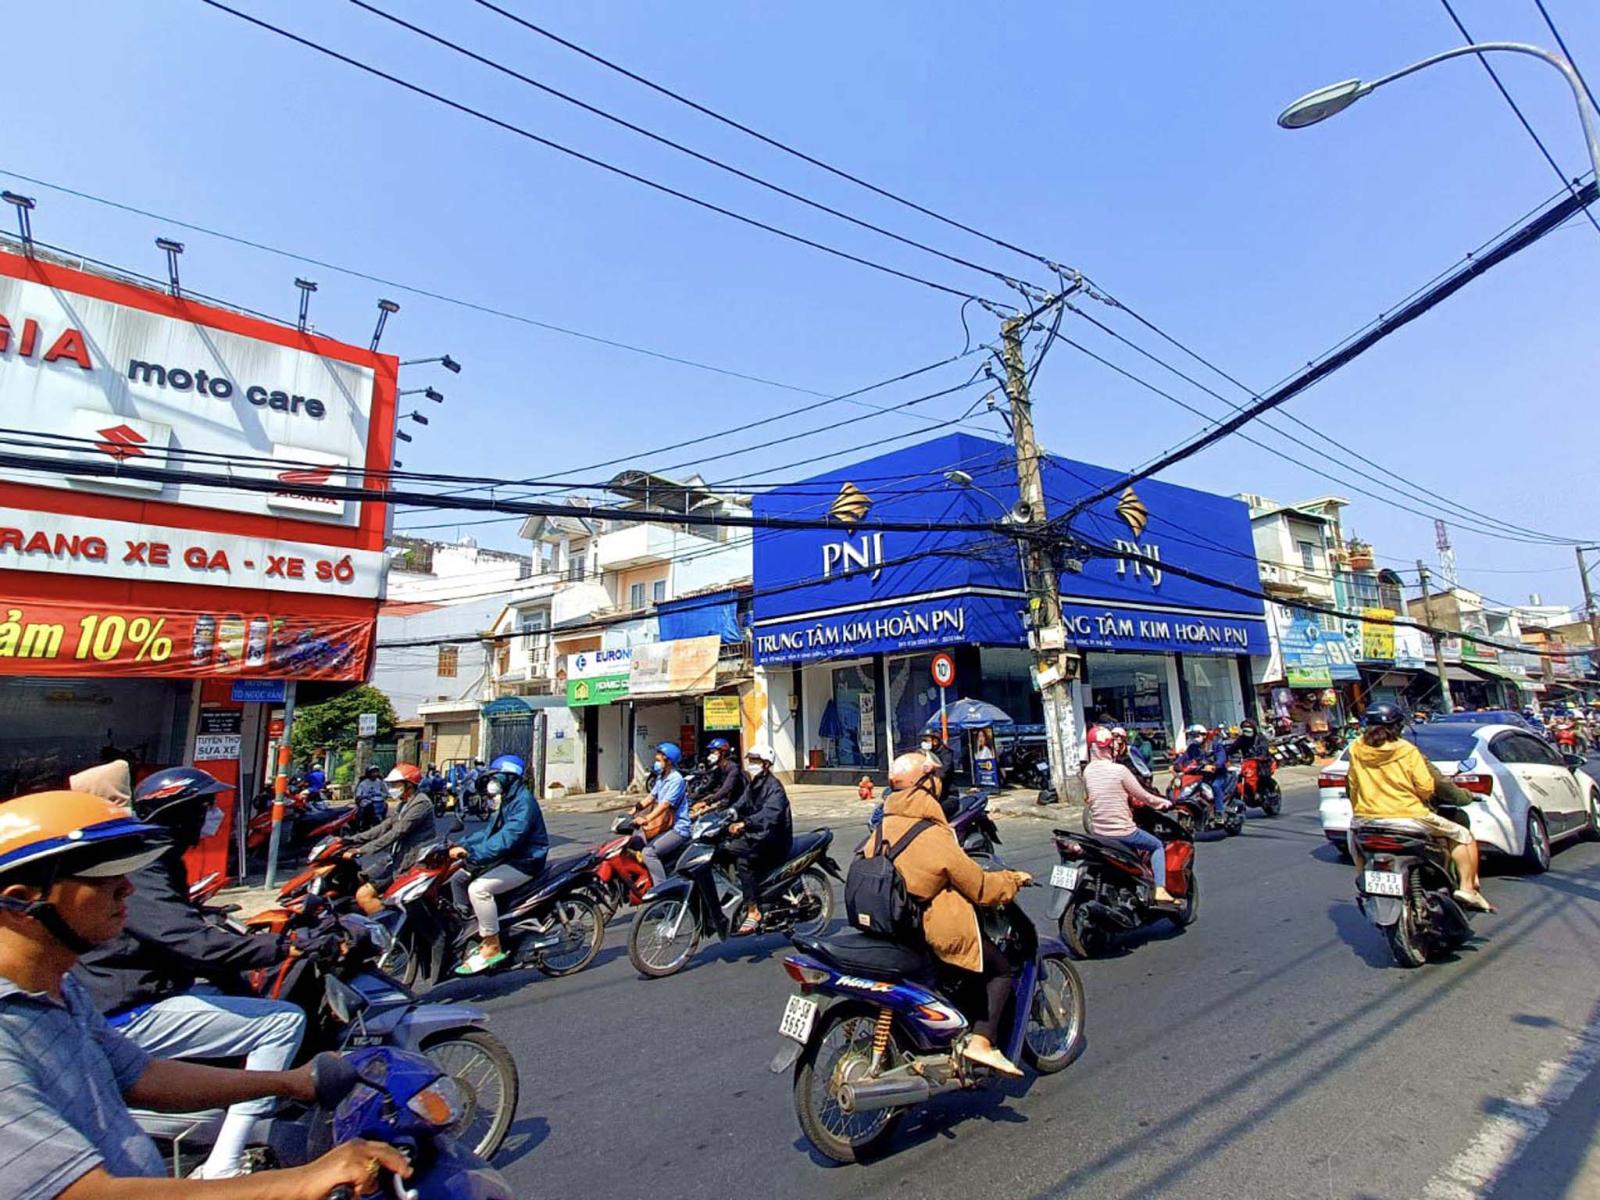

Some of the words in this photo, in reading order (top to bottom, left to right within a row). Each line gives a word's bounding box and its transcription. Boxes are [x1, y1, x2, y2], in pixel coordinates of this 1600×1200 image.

[128, 359, 233, 398] moto
[246, 385, 327, 418] care
[123, 541, 170, 565] XE
[183, 546, 231, 571] GA
[265, 555, 305, 578] XE
[315, 554, 355, 582] SỐ
[822, 531, 882, 581] PNJ
[75, 614, 173, 662] 10%
[756, 631, 803, 653] TRUNG
[806, 623, 839, 647] TÂM
[843, 621, 872, 642] KIM
[875, 610, 929, 637] HOÀN
[932, 607, 965, 632] PNJ
[1096, 612, 1135, 637] TÂM
[1140, 620, 1170, 639] KIM
[1175, 619, 1221, 642] HOÀN
[1224, 626, 1248, 646] PNJ
